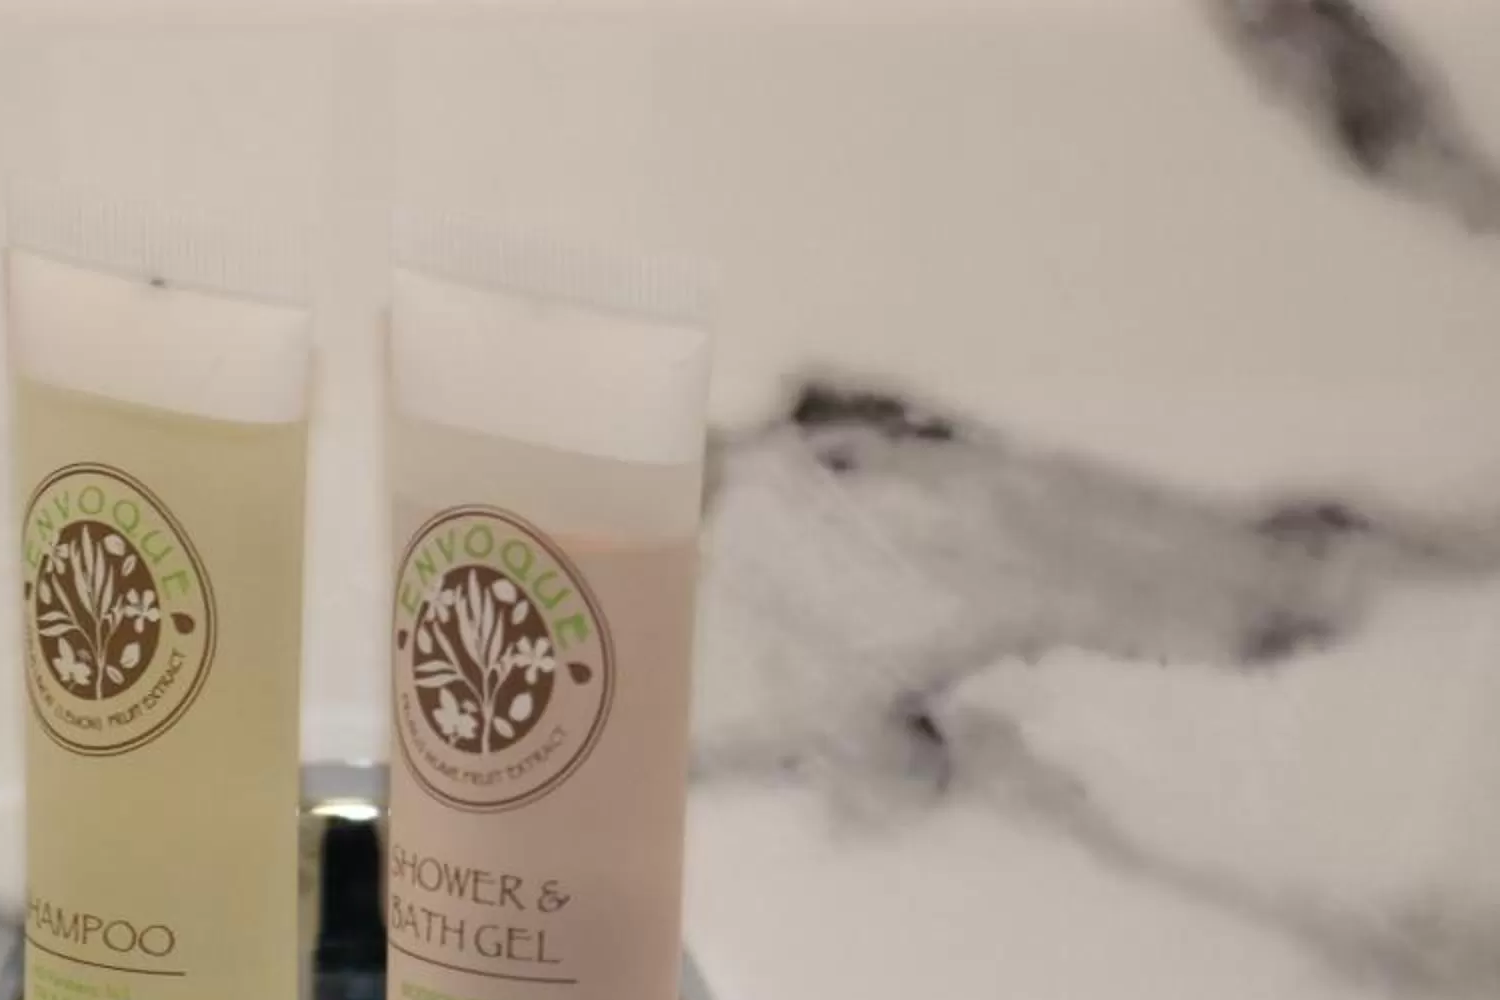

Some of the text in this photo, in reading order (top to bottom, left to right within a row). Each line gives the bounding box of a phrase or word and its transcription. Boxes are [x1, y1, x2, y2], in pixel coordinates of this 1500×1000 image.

[25, 484, 192, 598] ENVOQUE
[399, 521, 591, 650] ENVOQUE
[141, 647, 187, 710] EXTRACT
[391, 845, 572, 912] SHOWER &
[28, 897, 175, 957] HAMPOO
[391, 895, 564, 964] BATH GEL
